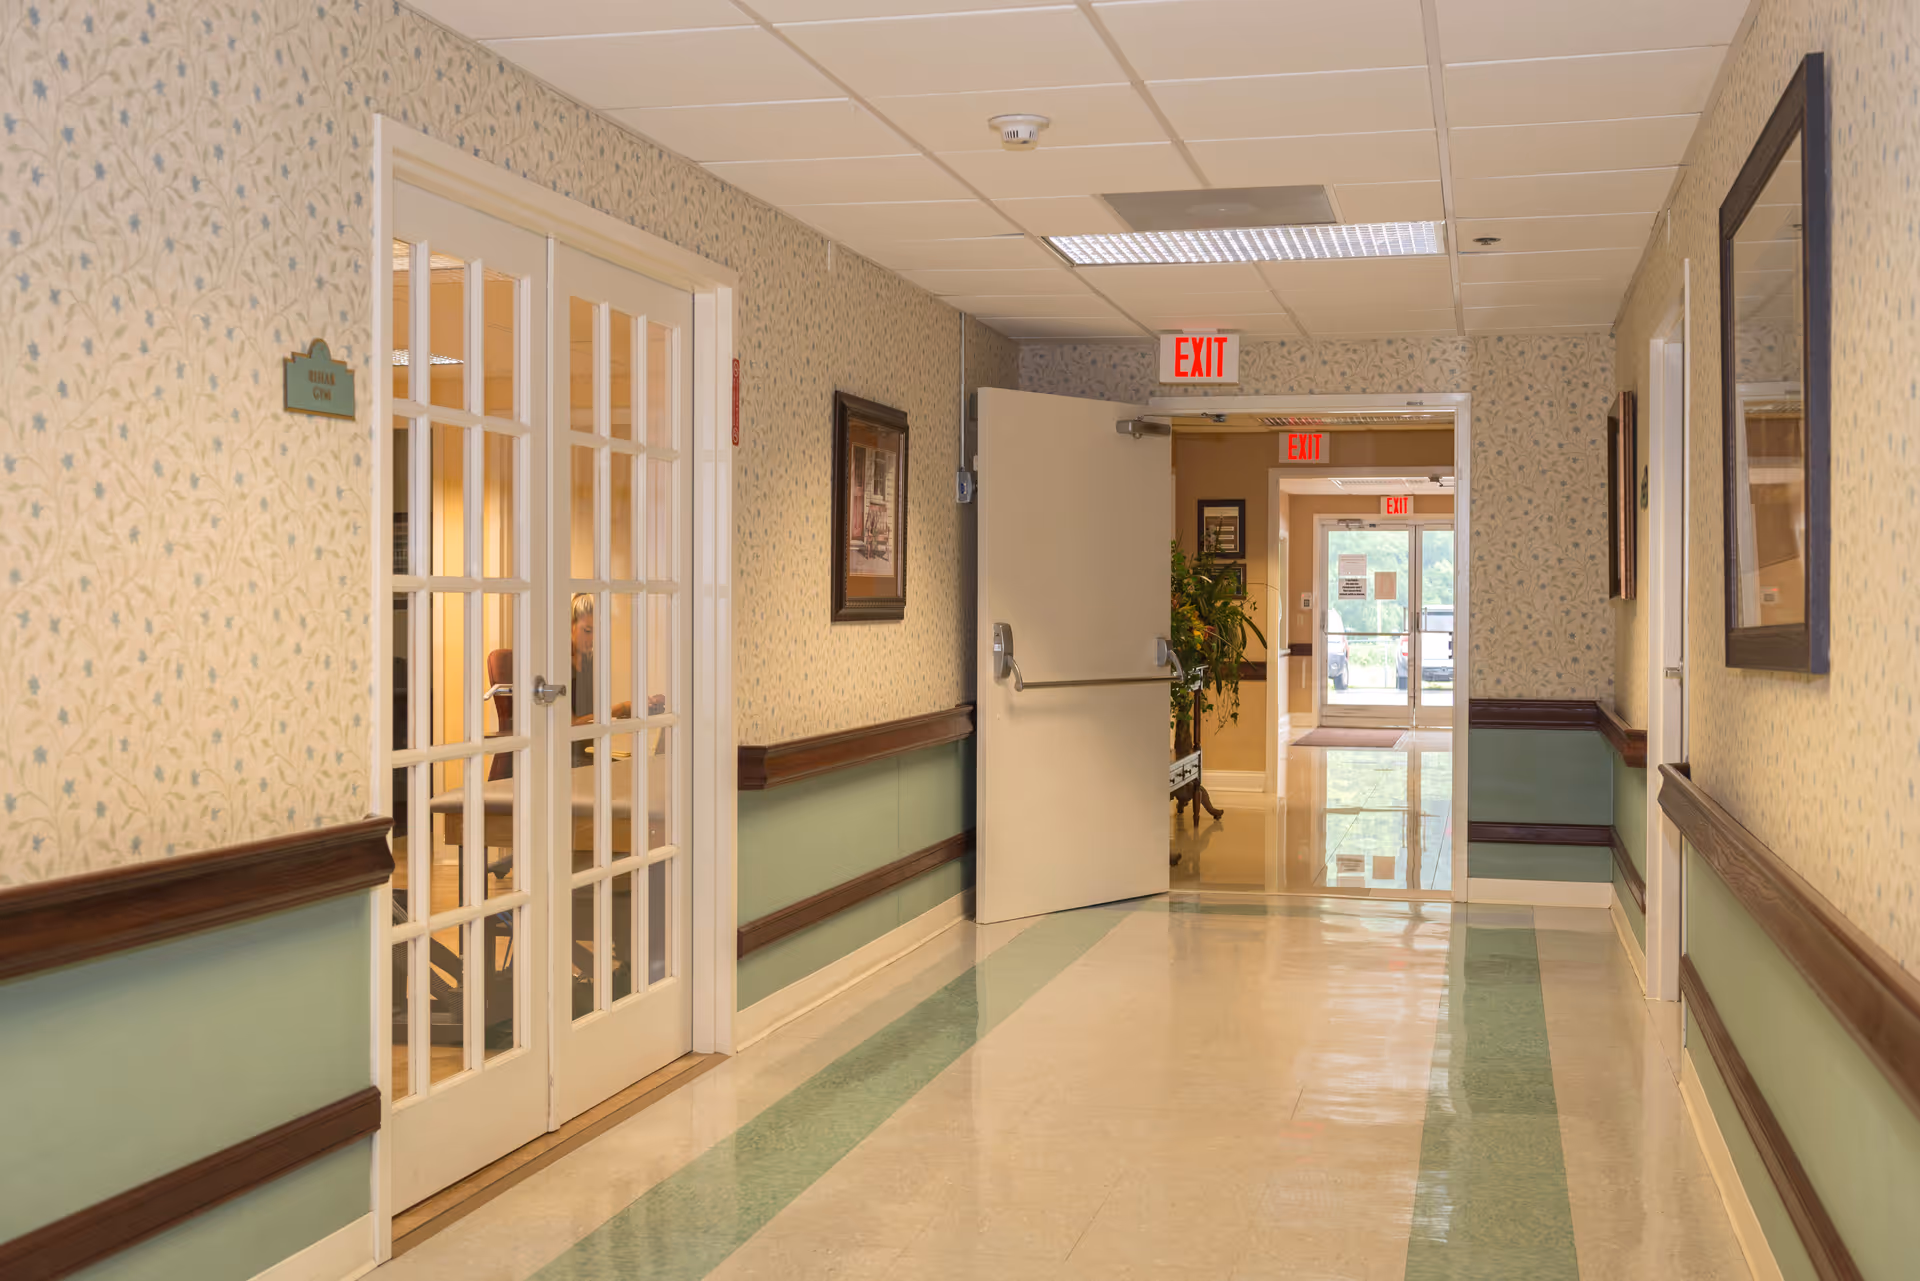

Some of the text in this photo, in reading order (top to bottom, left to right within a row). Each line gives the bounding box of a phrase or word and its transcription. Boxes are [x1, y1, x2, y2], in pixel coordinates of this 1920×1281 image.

[1174, 336, 1228, 378] EXIT
[1287, 433, 1323, 461] EXIT
[1386, 497, 1409, 515] EXIT
